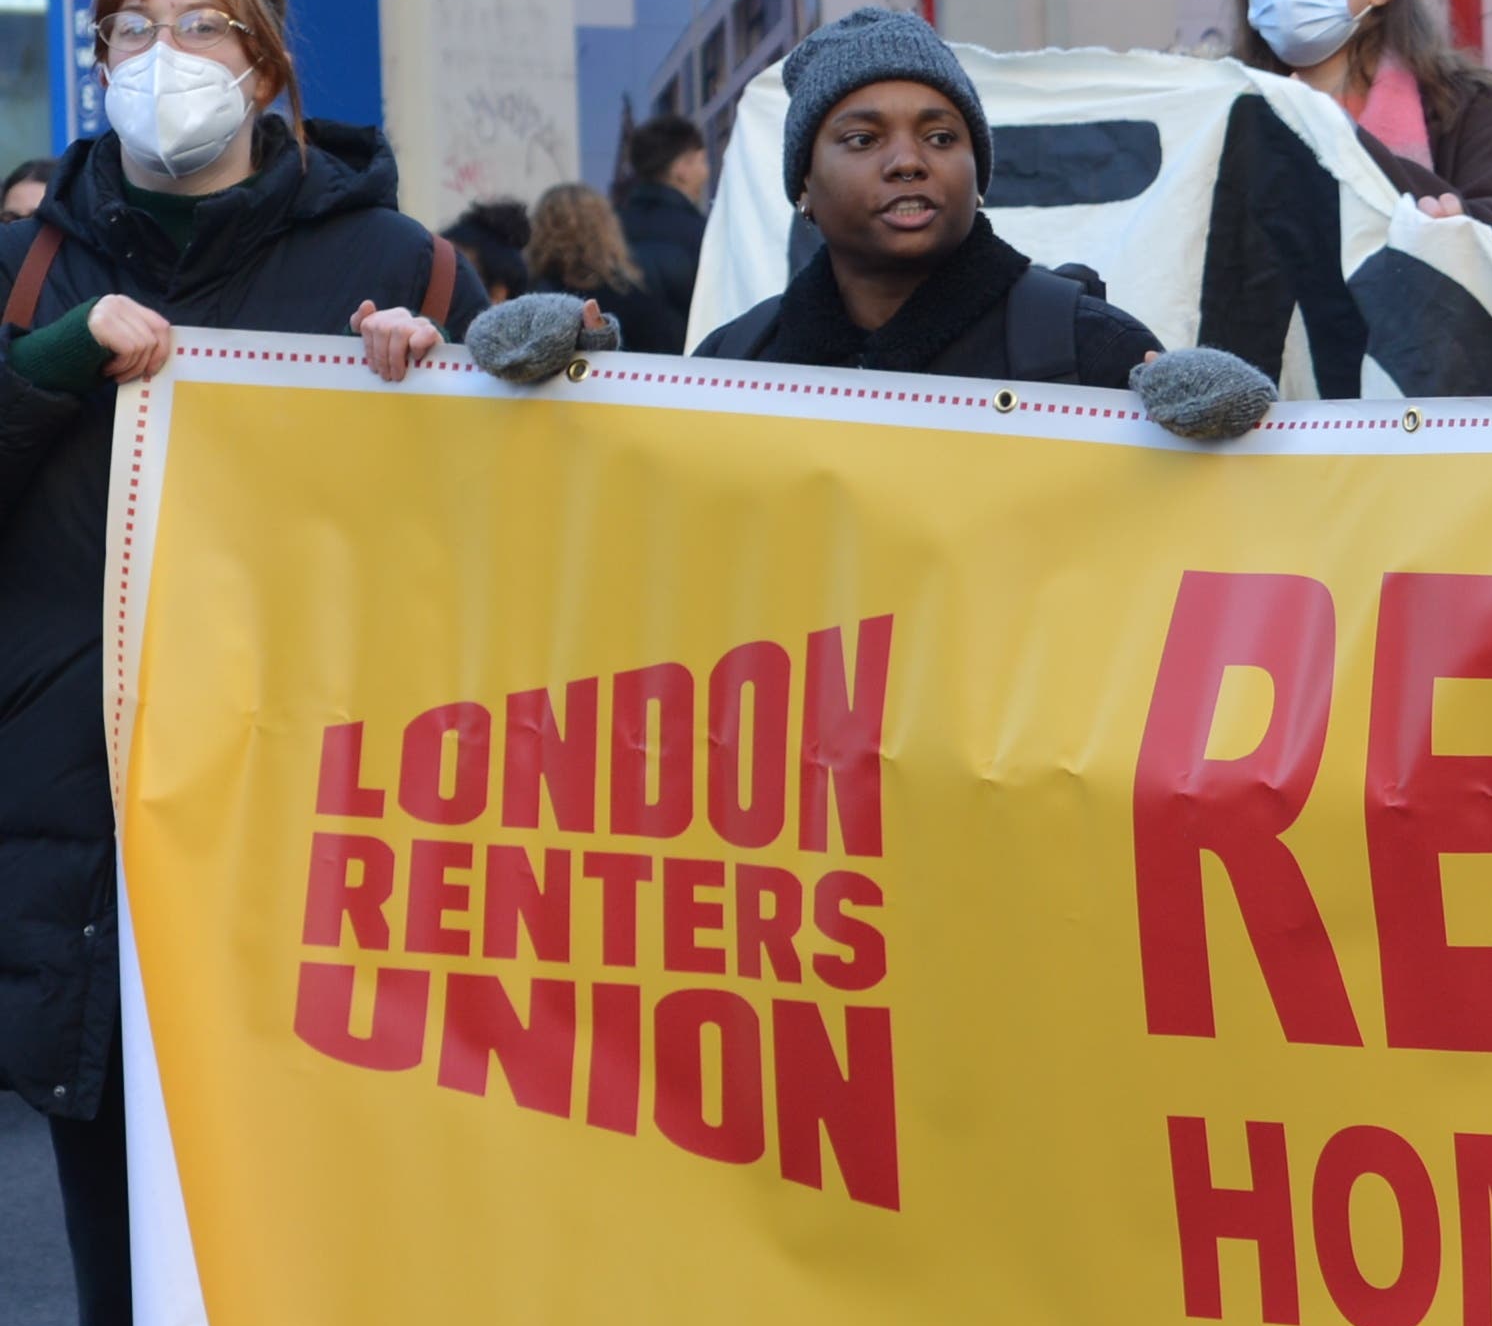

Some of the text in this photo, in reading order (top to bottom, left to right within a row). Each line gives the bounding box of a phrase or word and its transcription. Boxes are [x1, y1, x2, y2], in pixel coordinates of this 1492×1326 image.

[315, 612, 895, 858] LONDON
[301, 830, 888, 992] RENTERS
[292, 960, 901, 1214] UNION
